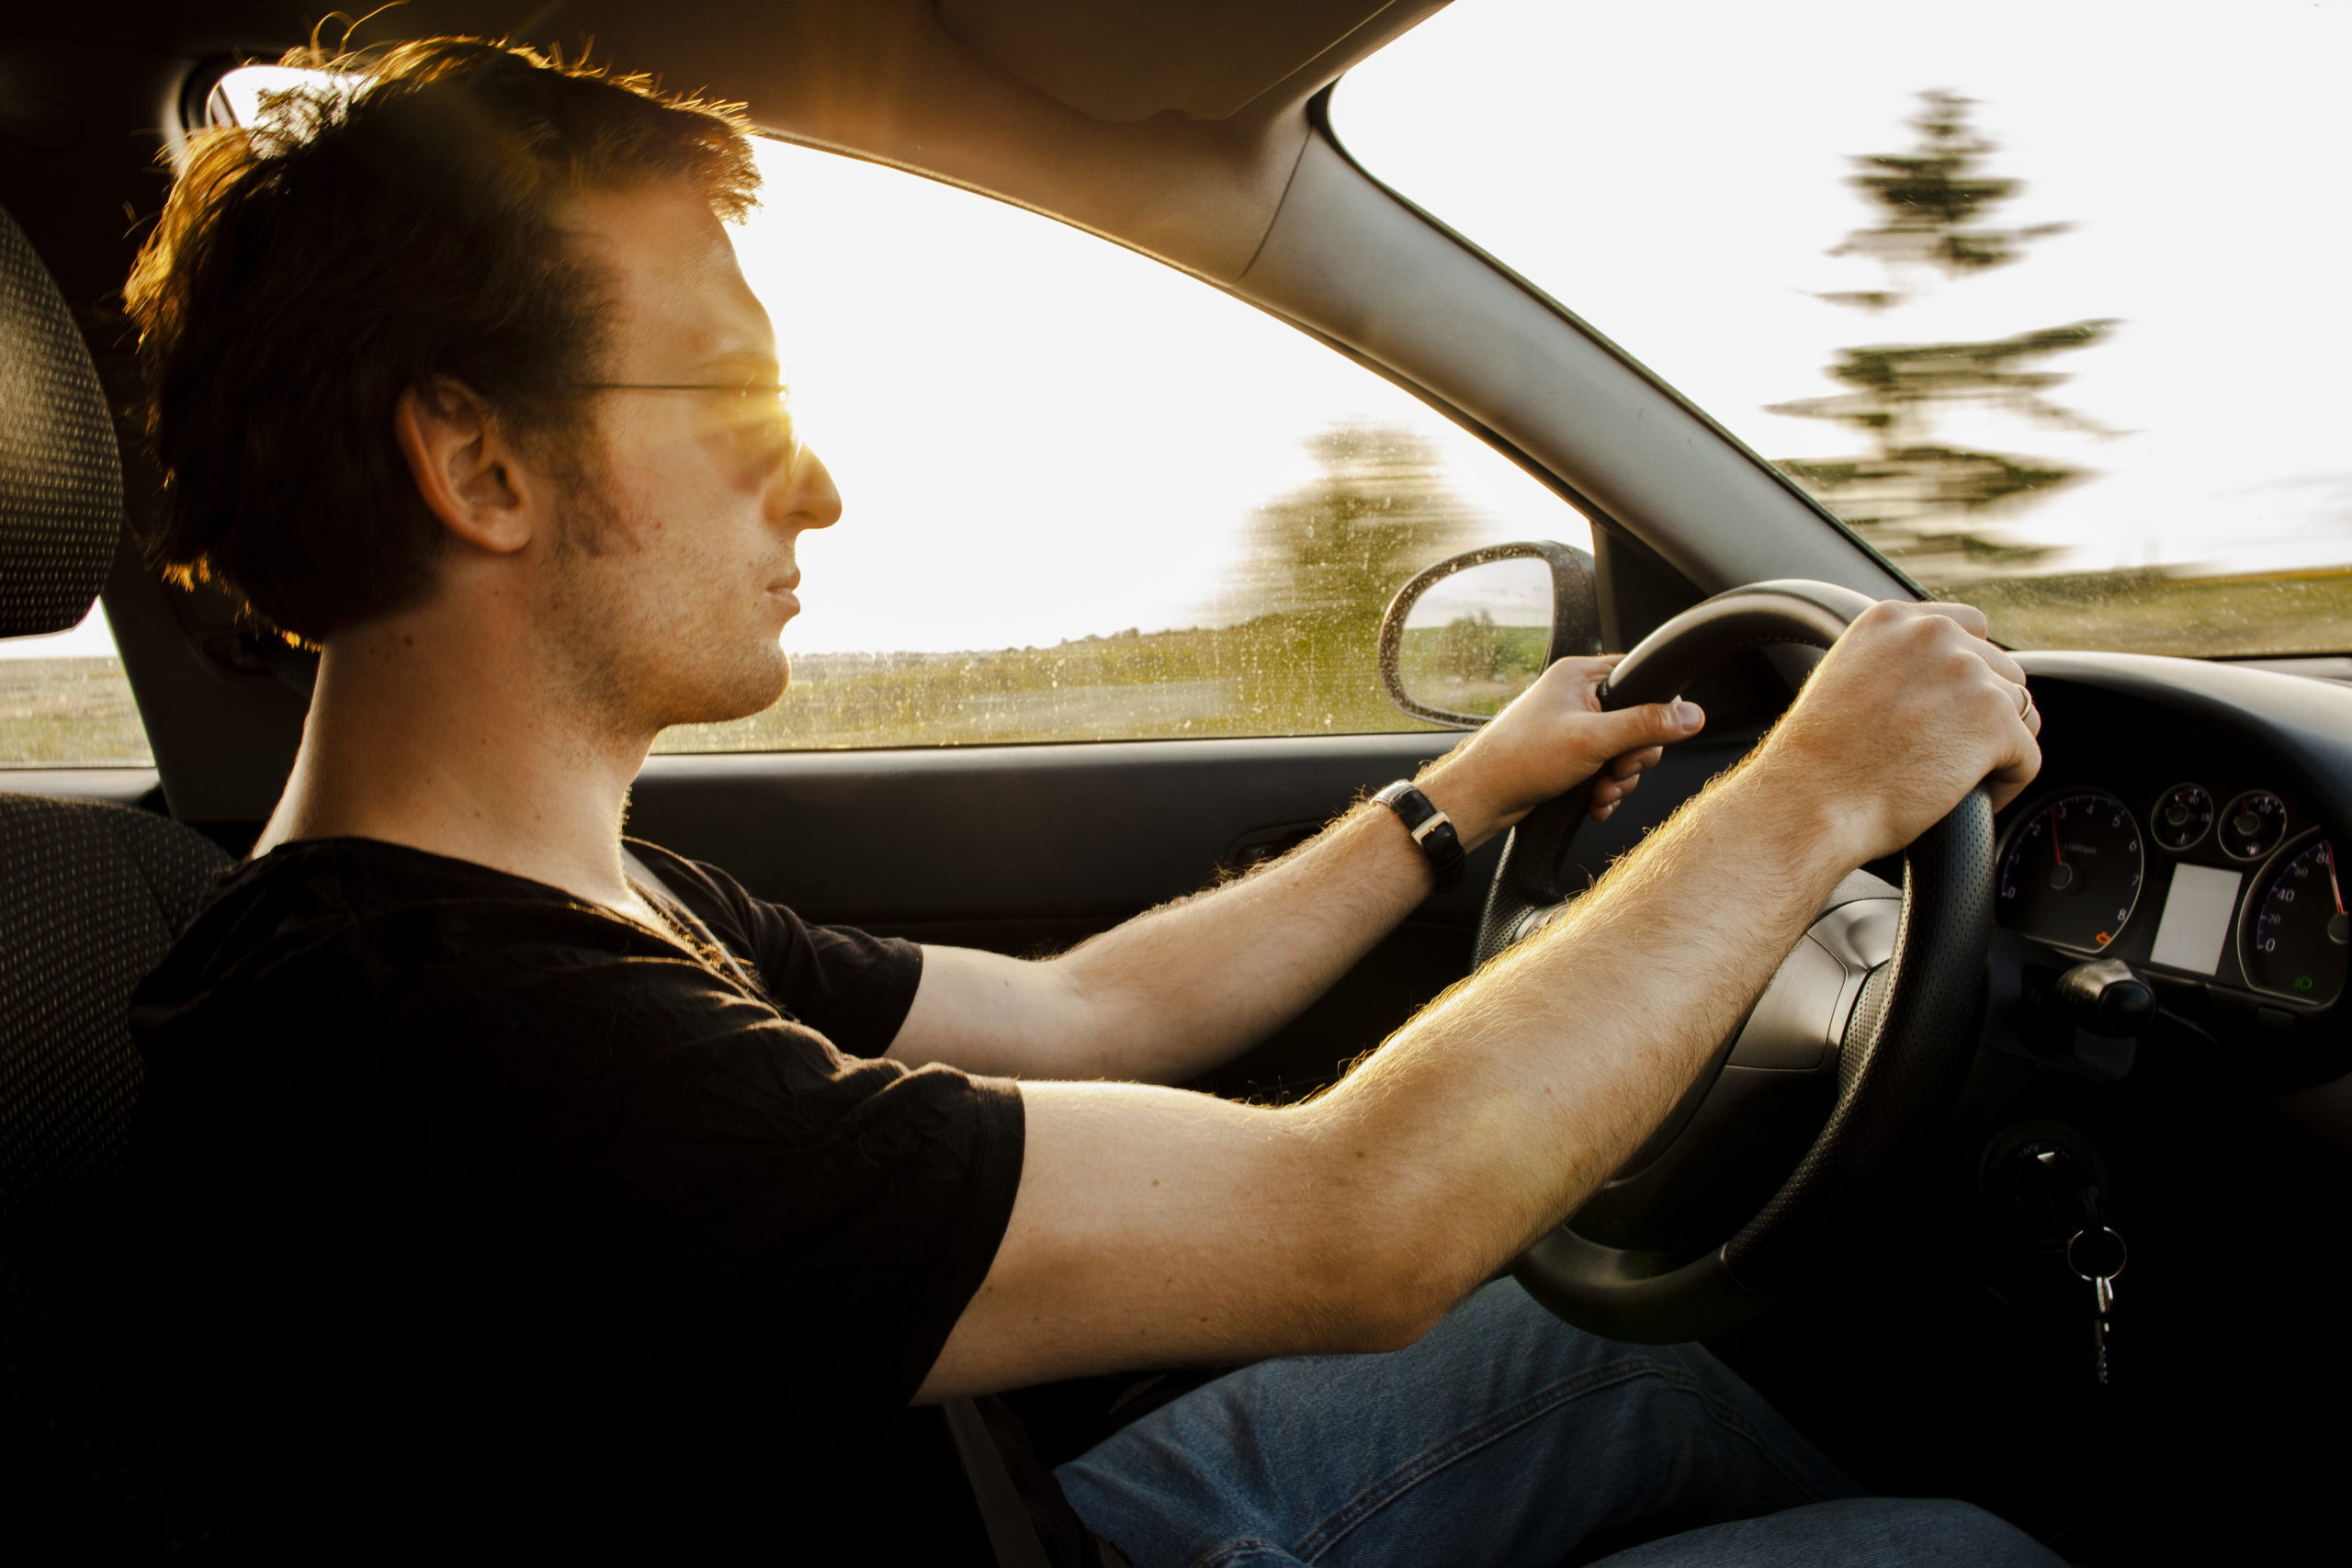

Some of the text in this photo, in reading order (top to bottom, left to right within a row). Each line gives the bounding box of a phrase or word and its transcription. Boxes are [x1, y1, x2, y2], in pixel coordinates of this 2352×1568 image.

[2086, 804, 2095, 815] 4
[2112, 815, 2120, 828] 5
[2033, 824, 2041, 837] 2
[2129, 840, 2138, 852] 6
[2007, 886, 2016, 898] 0
[2277, 888, 2295, 903] 40
[2117, 908, 2127, 921] 8
[2265, 938, 2277, 953] 0
